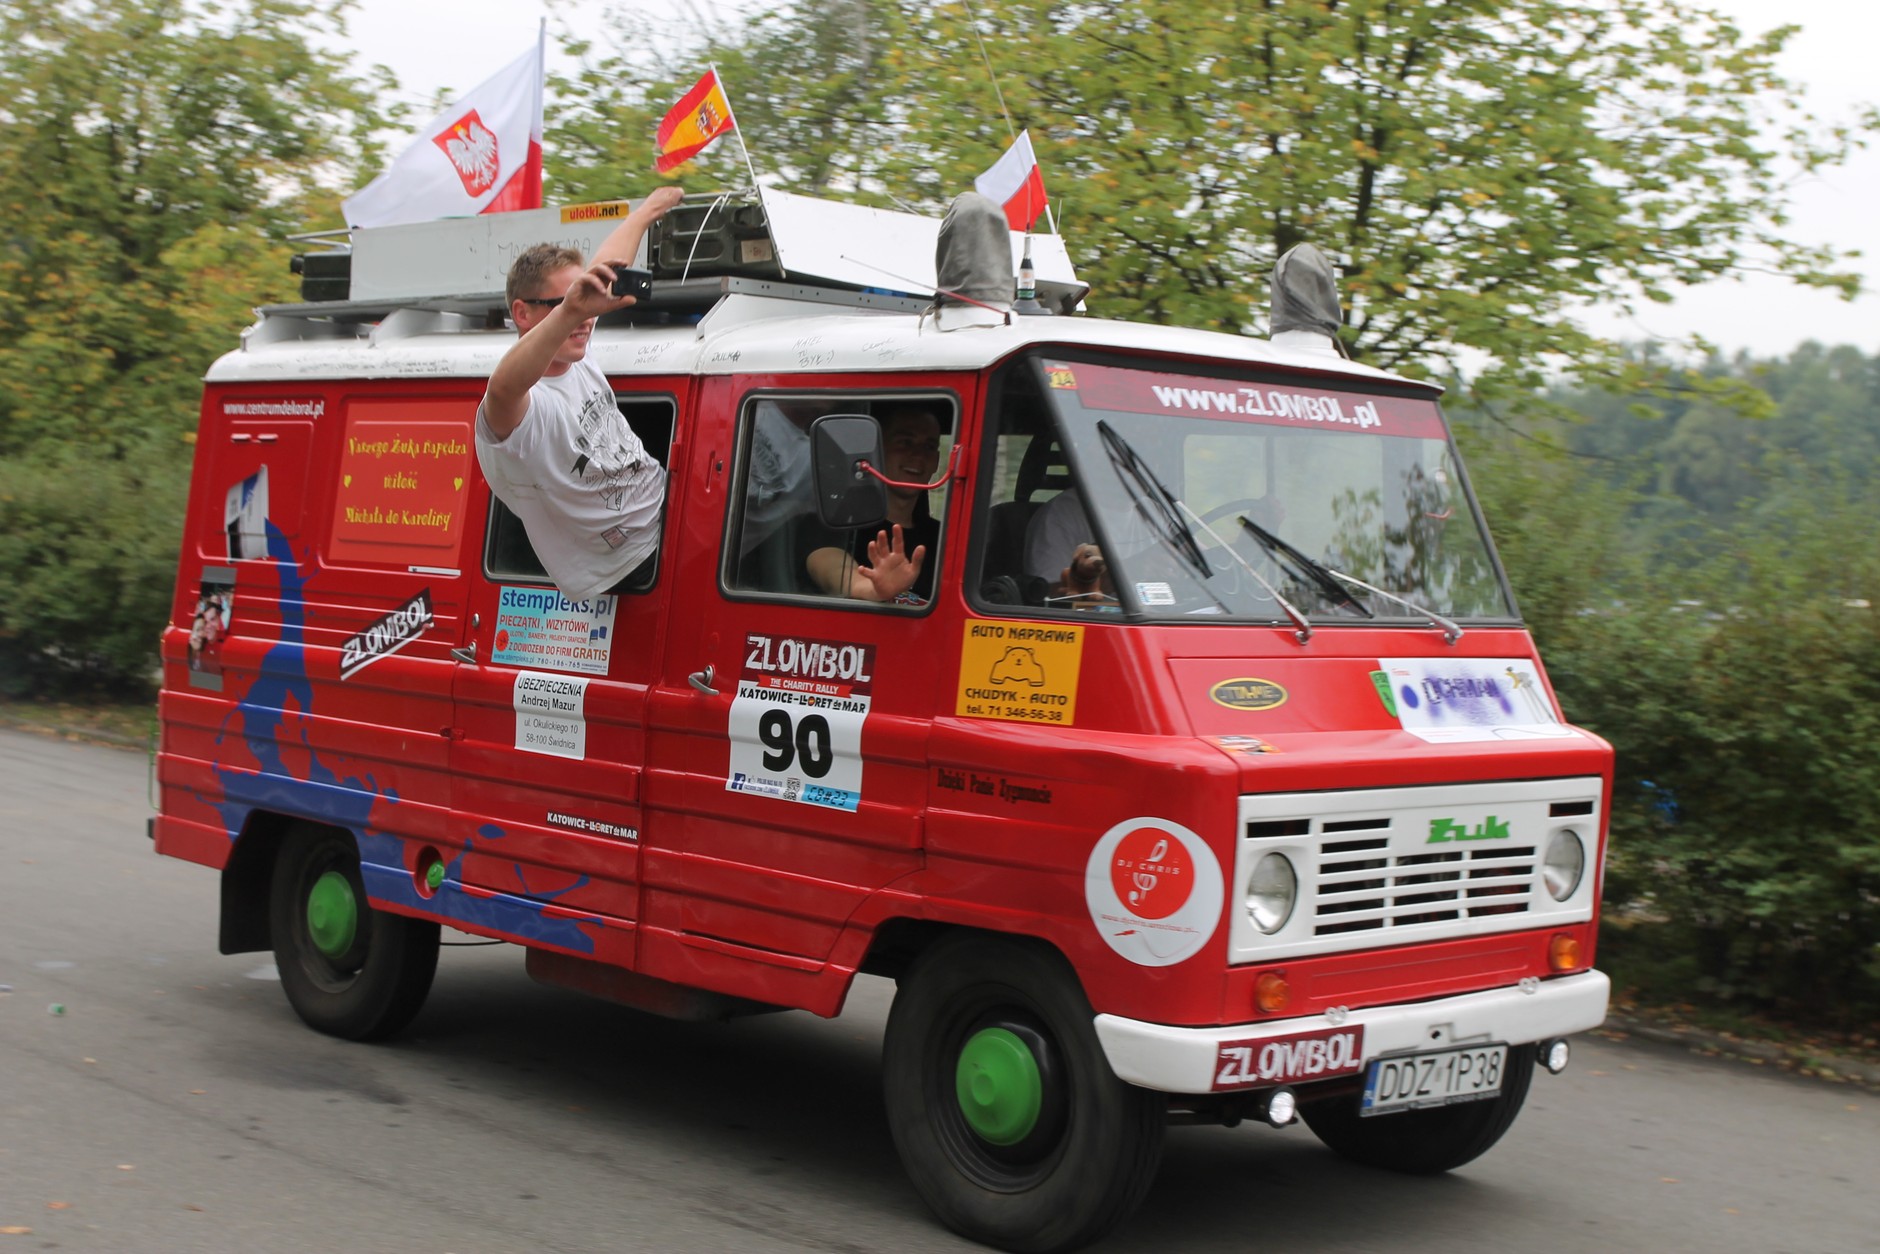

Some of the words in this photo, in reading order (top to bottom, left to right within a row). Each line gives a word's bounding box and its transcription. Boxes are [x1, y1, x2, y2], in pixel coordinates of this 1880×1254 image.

[570, 204, 619, 220] ulotki.net
[1152, 385, 1382, 428] www.ZLOMBOL.pl
[385, 509, 400, 524] do
[341, 597, 432, 668] ZLOMBOL
[546, 618, 590, 634] WIZYTÓWKI
[971, 625, 1004, 638] AUTO
[1008, 628, 1076, 643] NAPRAWA
[508, 642, 513, 651] Z
[513, 642, 544, 654] DOWOZEM
[545, 645, 555, 655] DO
[556, 646, 572, 657] FIRM
[572, 647, 608, 662] GRATIS
[745, 635, 872, 683] ZLOMBOL
[517, 677, 582, 698] UBEZPIECZENIA
[769, 677, 781, 688] THE
[782, 679, 814, 692] CHARITY
[815, 682, 839, 695] RALLY
[521, 694, 550, 711] Andrzej
[552, 697, 576, 712] Mazur
[965, 688, 1017, 702] CHUDYK
[1030, 693, 1068, 706] AUTO
[841, 701, 866, 714] MAR
[966, 704, 984, 715] tel.
[988, 705, 1001, 716] 71
[1005, 706, 1063, 722] 346-56-38
[533, 718, 569, 734] Okulickiego
[570, 723, 579, 734] 10
[525, 733, 547, 746] 58-100
[548, 734, 576, 750] Świdnica
[759, 709, 833, 778] 90
[620, 828, 638, 840] MAR
[1139, 863, 1180, 875] CHRIS
[1216, 1033, 1360, 1085] ZLOMBOL
[1380, 1058, 1436, 1101] DDZ
[1446, 1051, 1501, 1092] 1P38
